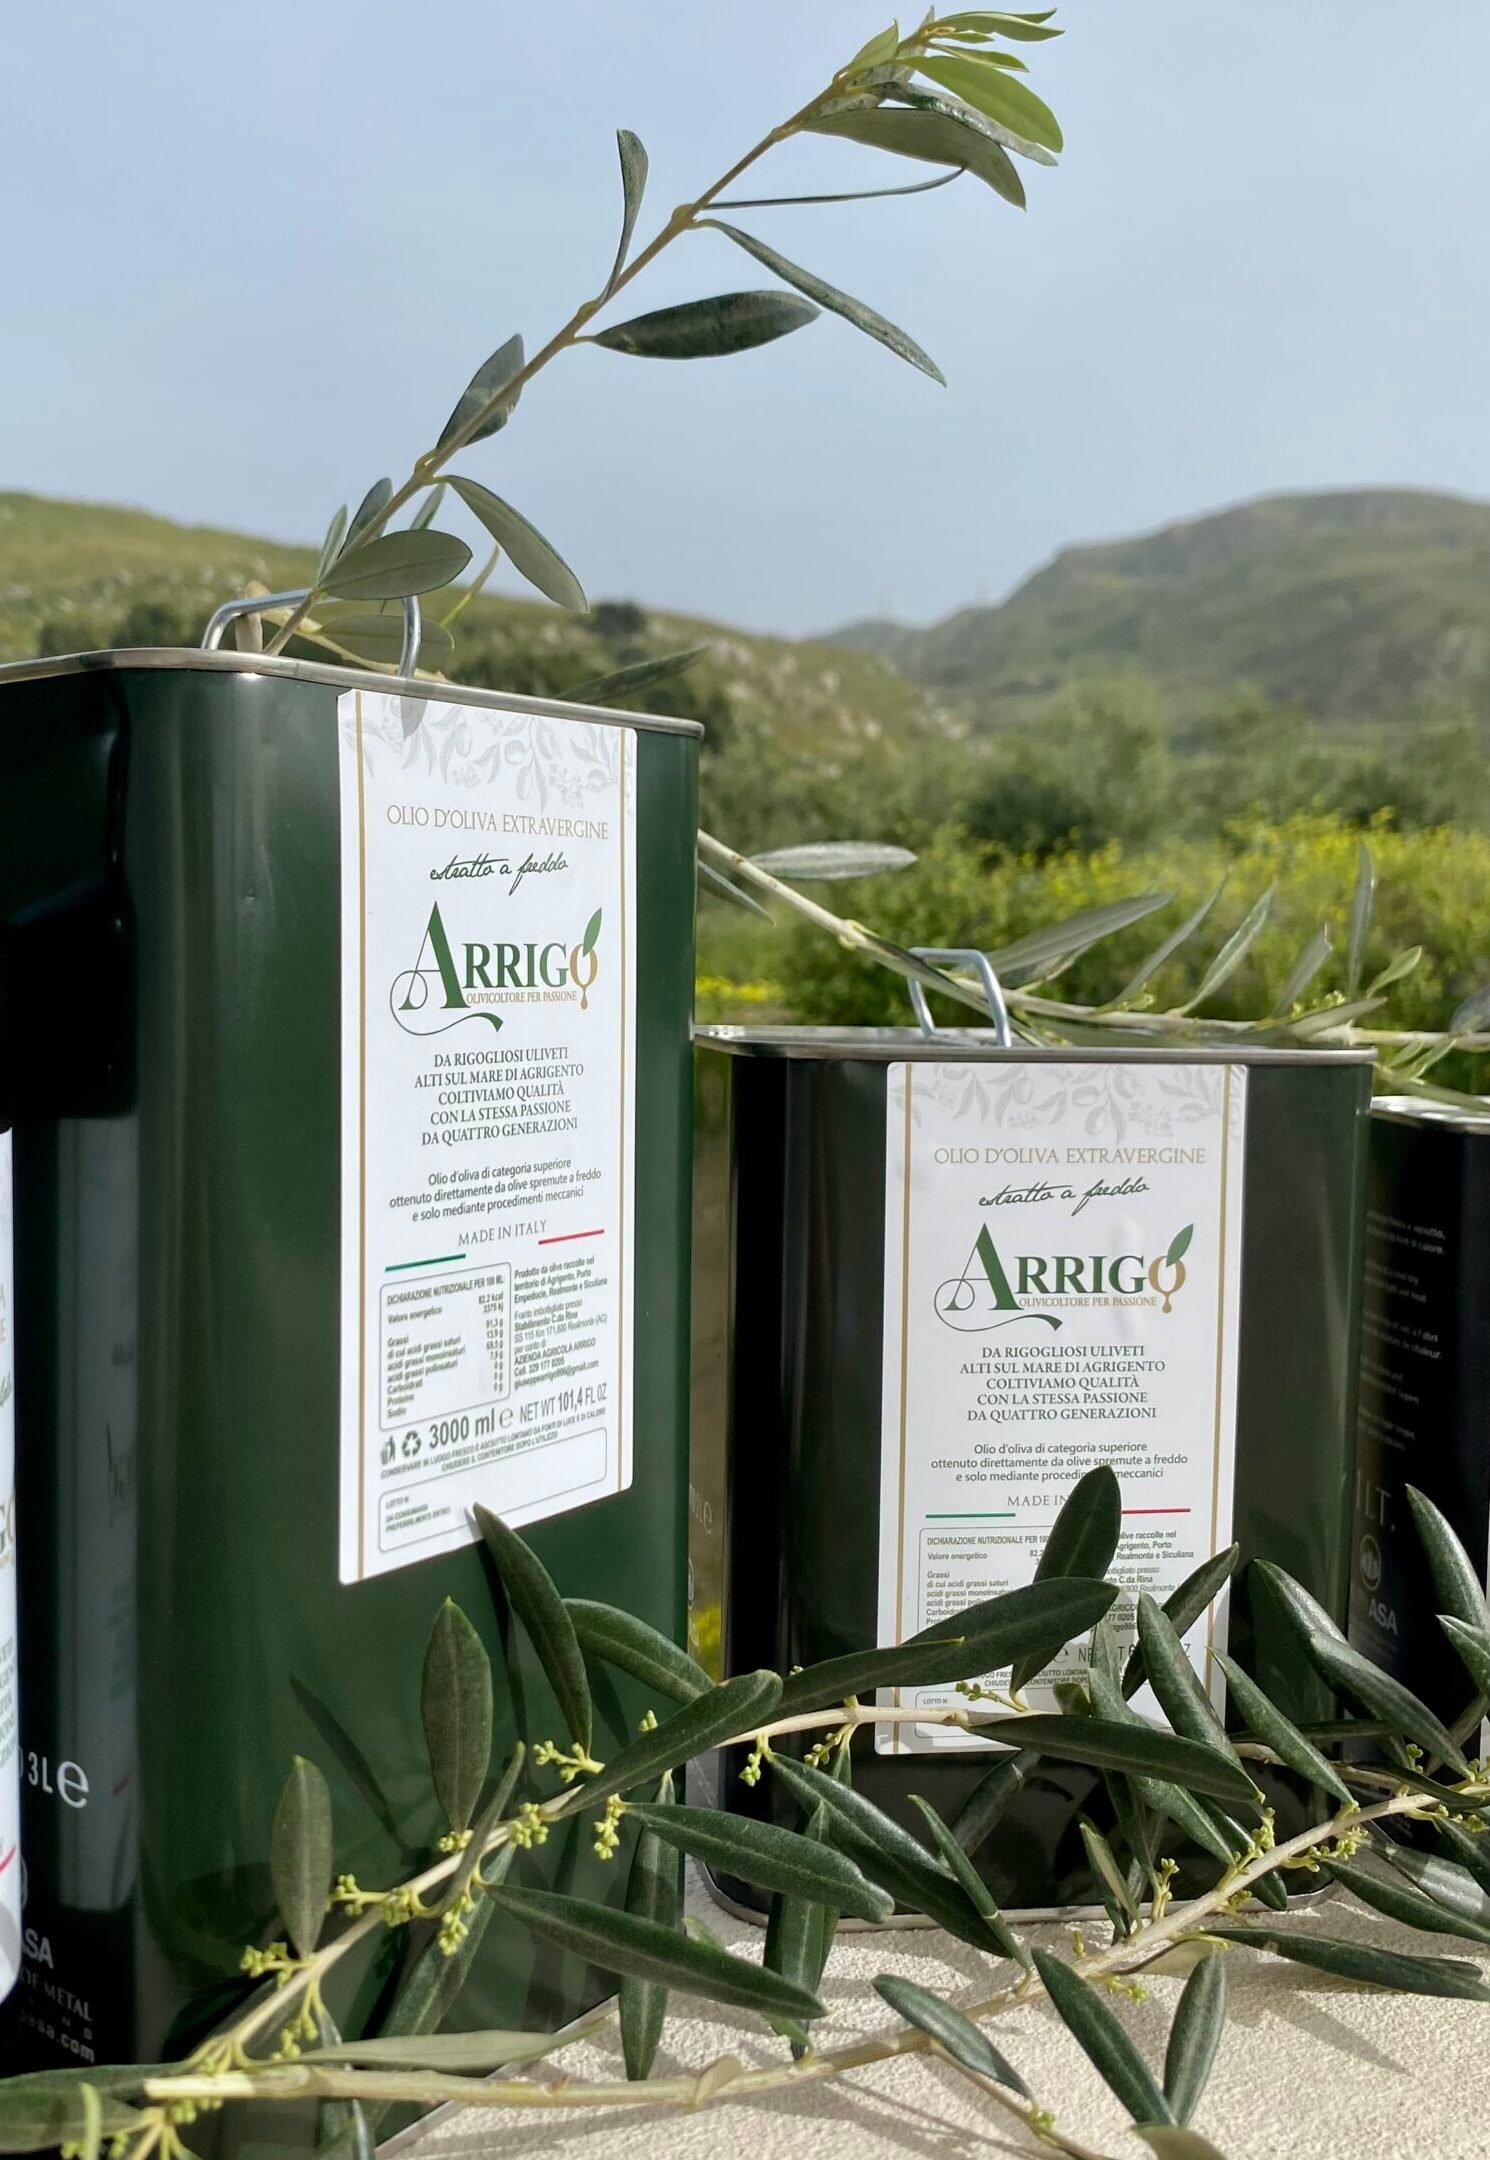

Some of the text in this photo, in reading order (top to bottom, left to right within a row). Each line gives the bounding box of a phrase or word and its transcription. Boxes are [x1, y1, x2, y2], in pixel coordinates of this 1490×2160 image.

[387, 805, 428, 827] OLIO
[503, 813, 608, 839] EXTRAVERGINE
[430, 853, 510, 882] estratto
[508, 851, 568, 895] freddo
[389, 901, 602, 1036] ARRIGO
[466, 990, 577, 1005] OLIVICOLTORE PER PASSIONE
[434, 1045, 568, 1067] DA RIGOGLIOSI ULIVETI
[415, 1063, 584, 1088] ALTI SUL MARE DI AGRIGENTO
[438, 1080, 565, 1106] COLTIVIAMO QUALITÀ
[430, 1099, 571, 1125] CON LA STESSA PASSIONE
[421, 1117, 578, 1147] DA QUATTRO GENERAZIONI
[934, 1149, 979, 1164] OLIO
[1066, 1147, 1206, 1164] EXTRAVERGINE
[428, 1173, 448, 1187] Olio
[481, 1167, 490, 1179] di
[491, 1161, 532, 1181] categoria
[533, 1157, 572, 1175] superiore
[389, 1167, 602, 1208] ottenuto direttamente da olive spremute a freddo
[978, 1181, 1055, 1207] estratto
[1071, 1176, 1150, 1216] freddo
[412, 1185, 584, 1222] e solo mediante procedimenti meccanici
[458, 1219, 547, 1247] MADE IN ITALY
[934, 1222, 1194, 1332] ARRIGO
[1018, 1296, 1157, 1308] OLIVICOLTORE PER PASSIONE
[982, 1345, 1145, 1360] DA RIGOGLIOSI ULIVETI
[960, 1360, 1166, 1375] ALTI SUL MARE DI AGRIGENTO
[986, 1373, 1140, 1391] COLTIVIAMO QUALITÀ
[977, 1391, 1148, 1406] CON LA STESSA PASSIONE
[429, 1415, 469, 1449] 3000
[475, 1407, 495, 1435] ml
[520, 1400, 539, 1423] NET
[540, 1395, 556, 1417] WT
[558, 1387, 583, 1412] 101,4
[585, 1386, 596, 1405] FL
[967, 1407, 1157, 1424] DA QUATTRO GENERAZIONI
[931, 1453, 1188, 1468] ottenuto direttamente da olive spremute a freddo
[974, 1444, 996, 1454] Olio
[1037, 1443, 1045, 1453] di
[1047, 1443, 1096, 1456] categoria
[1098, 1442, 1148, 1455] superiore
[955, 1474, 962, 1482] e
[965, 1471, 987, 1481] solo
[989, 1470, 1039, 1481] mediante
[1007, 1495, 1050, 1507] MADE
[22, 1927, 54, 1970] SA
